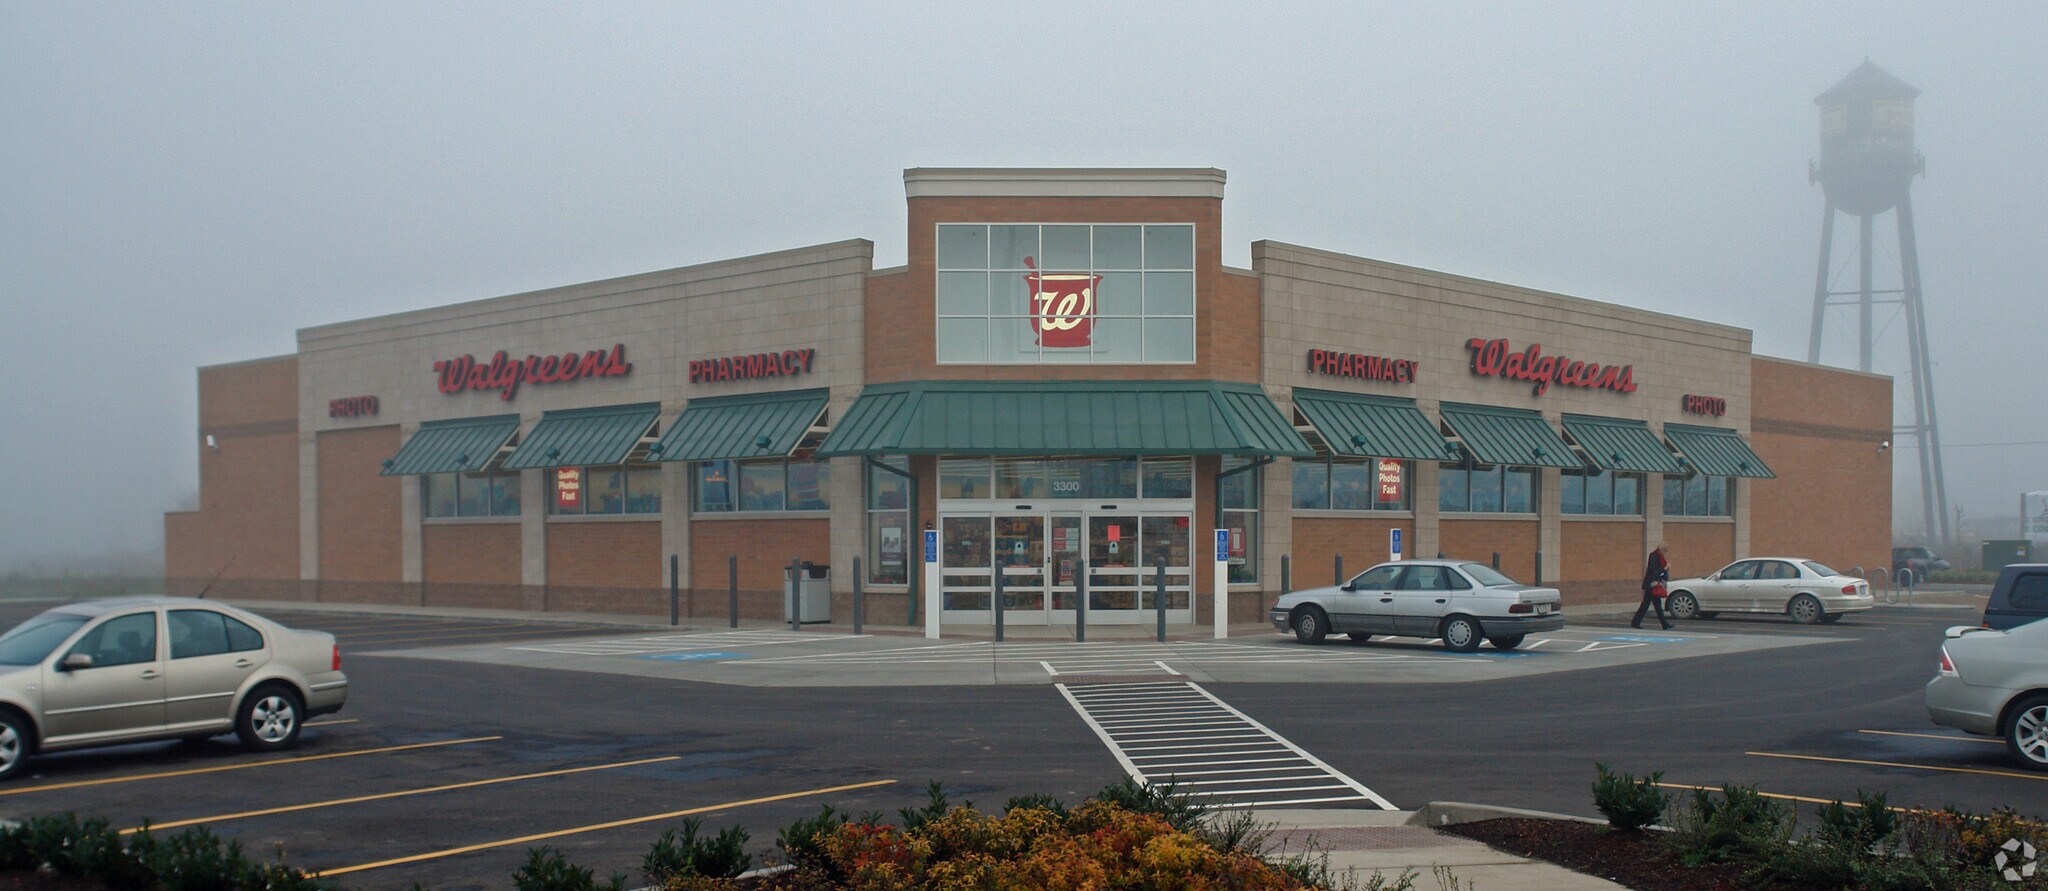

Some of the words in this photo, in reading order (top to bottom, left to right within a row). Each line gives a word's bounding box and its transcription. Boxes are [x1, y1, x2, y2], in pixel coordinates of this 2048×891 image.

[1034, 288, 1091, 331] W
[434, 344, 629, 401] Walgreens
[689, 349, 813, 383] PHARMACY
[1311, 349, 1419, 383] PHARMACY
[1469, 338, 1638, 396] Walgreens
[328, 396, 378, 417] PHOTO
[1685, 394, 1727, 417] PHOTO
[558, 470, 579, 480] Quality
[1378, 462, 1400, 473] Quality
[558, 481, 579, 490] Photos
[1379, 473, 1400, 482] Photos
[1052, 480, 1080, 493] 3300
[1382, 485, 1397, 494] Fast
[561, 491, 576, 500] Fast
